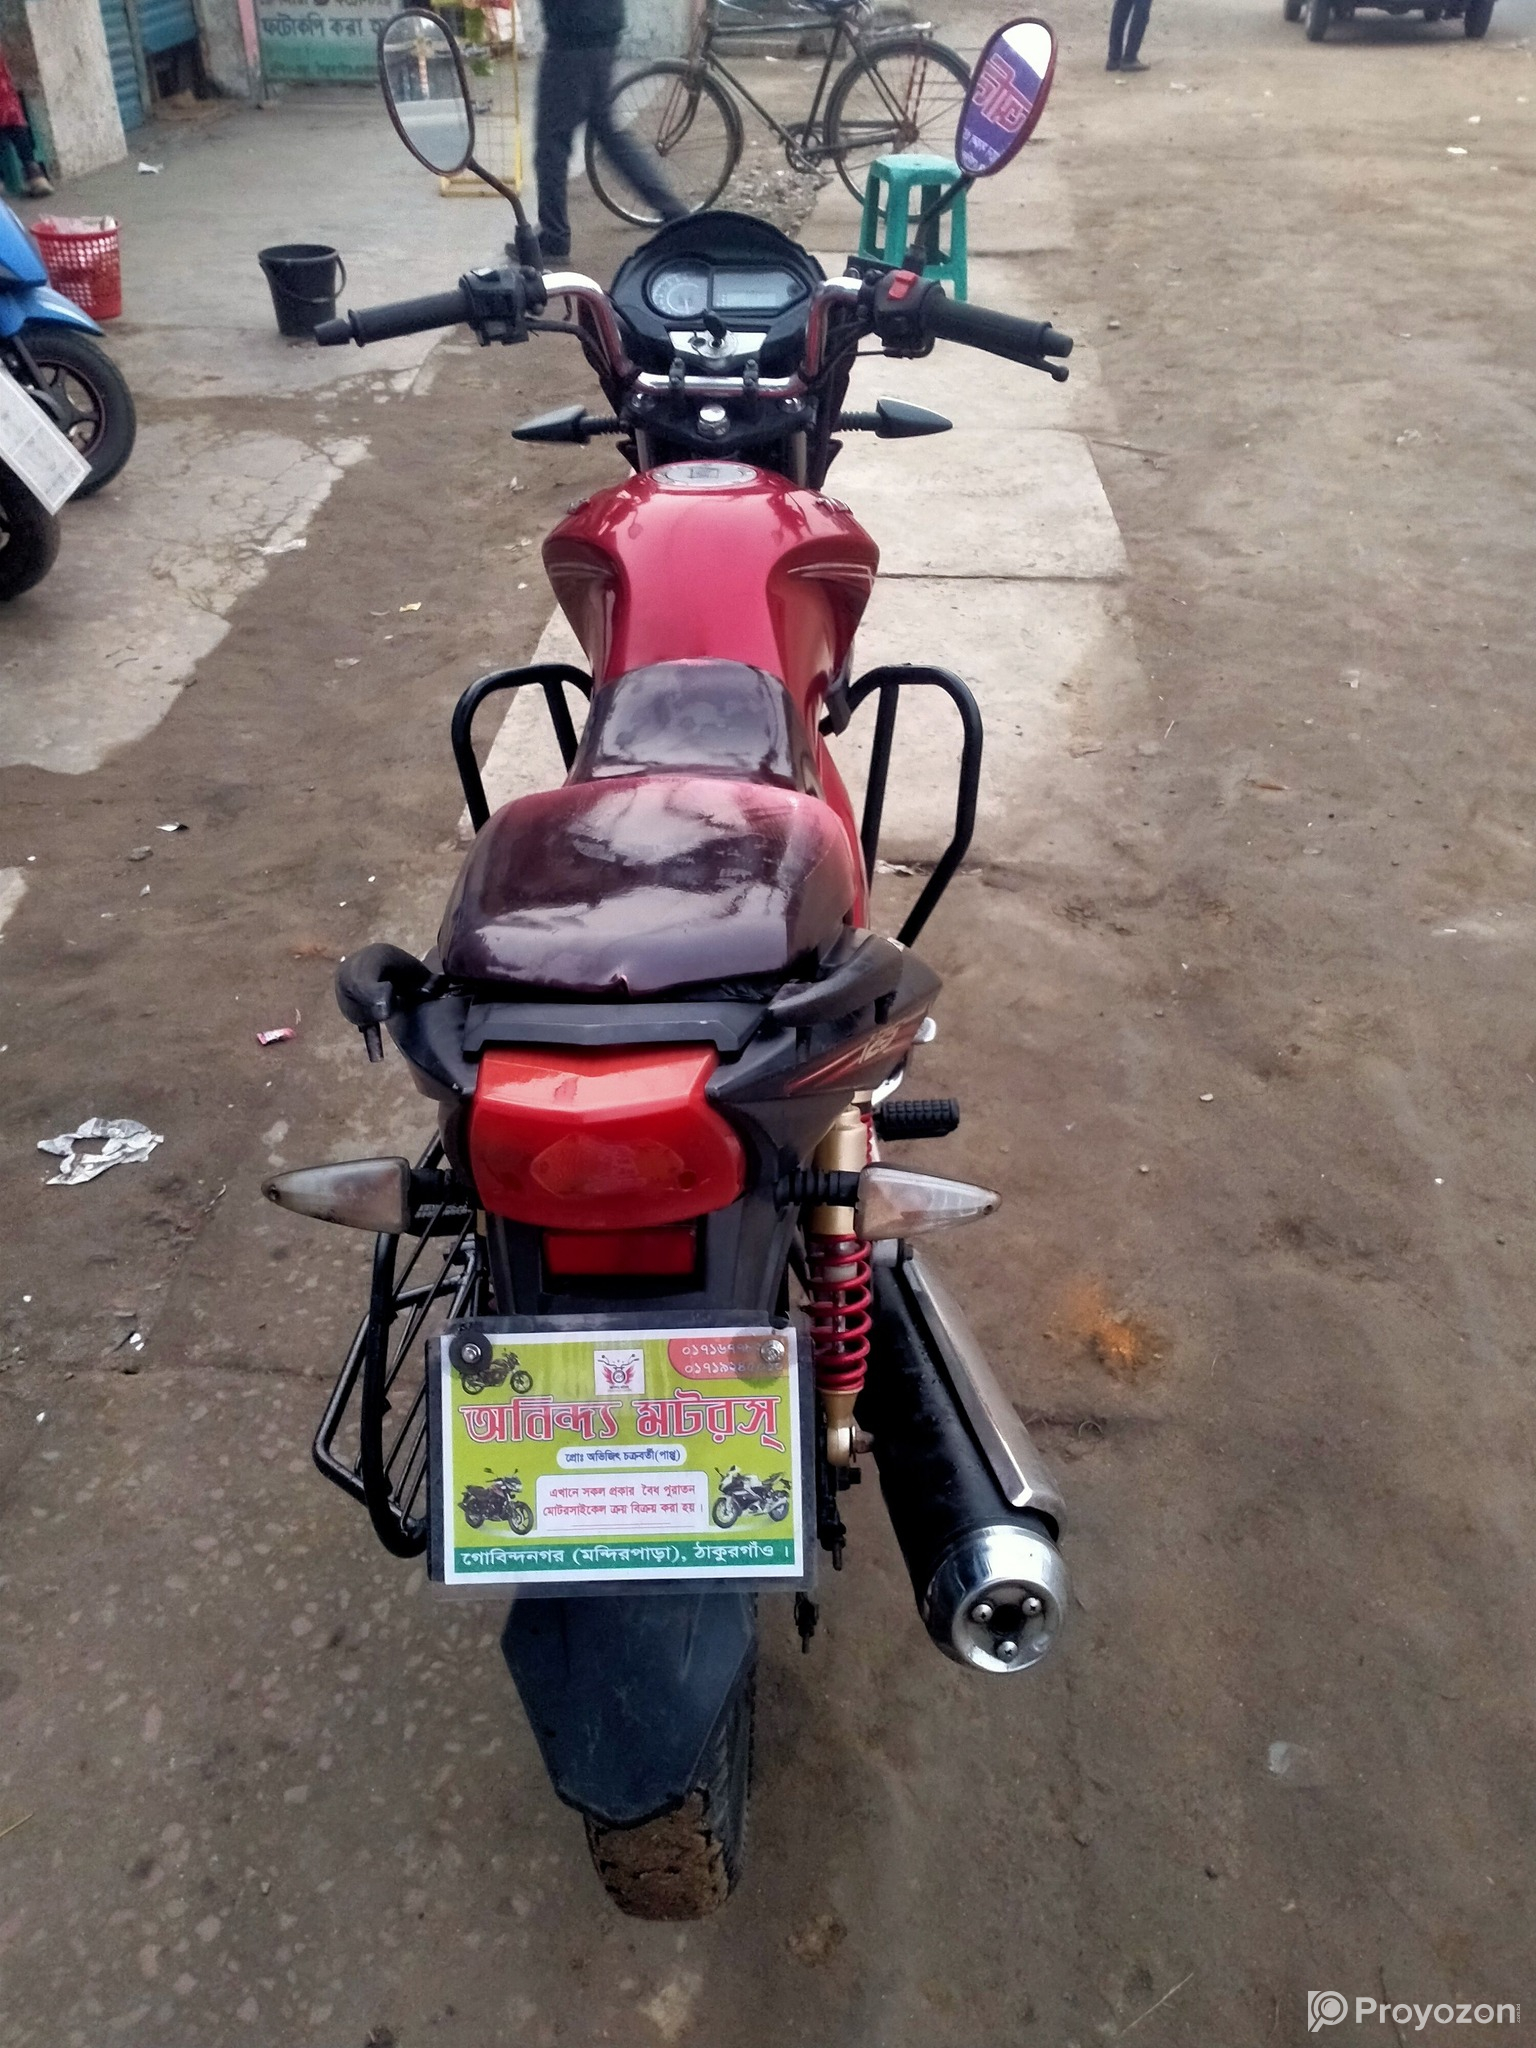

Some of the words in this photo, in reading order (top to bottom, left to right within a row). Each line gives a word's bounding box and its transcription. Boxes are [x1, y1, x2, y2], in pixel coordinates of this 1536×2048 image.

[261, 12, 325, 37] ফটোকপি
[328, 18, 363, 37] করা
[458, 1394, 623, 1443] অনিন্দ্য
[631, 1387, 786, 1453] মটরস্
[565, 1452, 584, 1463] প্রোঃ
[586, 1449, 621, 1462] অভিজিৎ
[549, 1487, 579, 1498] এখানে
[582, 1487, 605, 1497] সকল
[609, 1485, 635, 1497] প্রকার
[641, 1483, 660, 1496] বৈধ
[543, 1503, 607, 1516] মোটরসাইকেল
[610, 1503, 627, 1515] ক্রয়
[630, 1501, 657, 1514] বিক্রয়
[660, 1503, 678, 1513] করা
[681, 1502, 695, 1513] হয়
[461, 1547, 564, 1566] গোবিন্দনগর
[572, 1545, 687, 1566] (মন্দিরপাড়া),
[693, 1541, 774, 1562] ঠাকুরগাঁও
